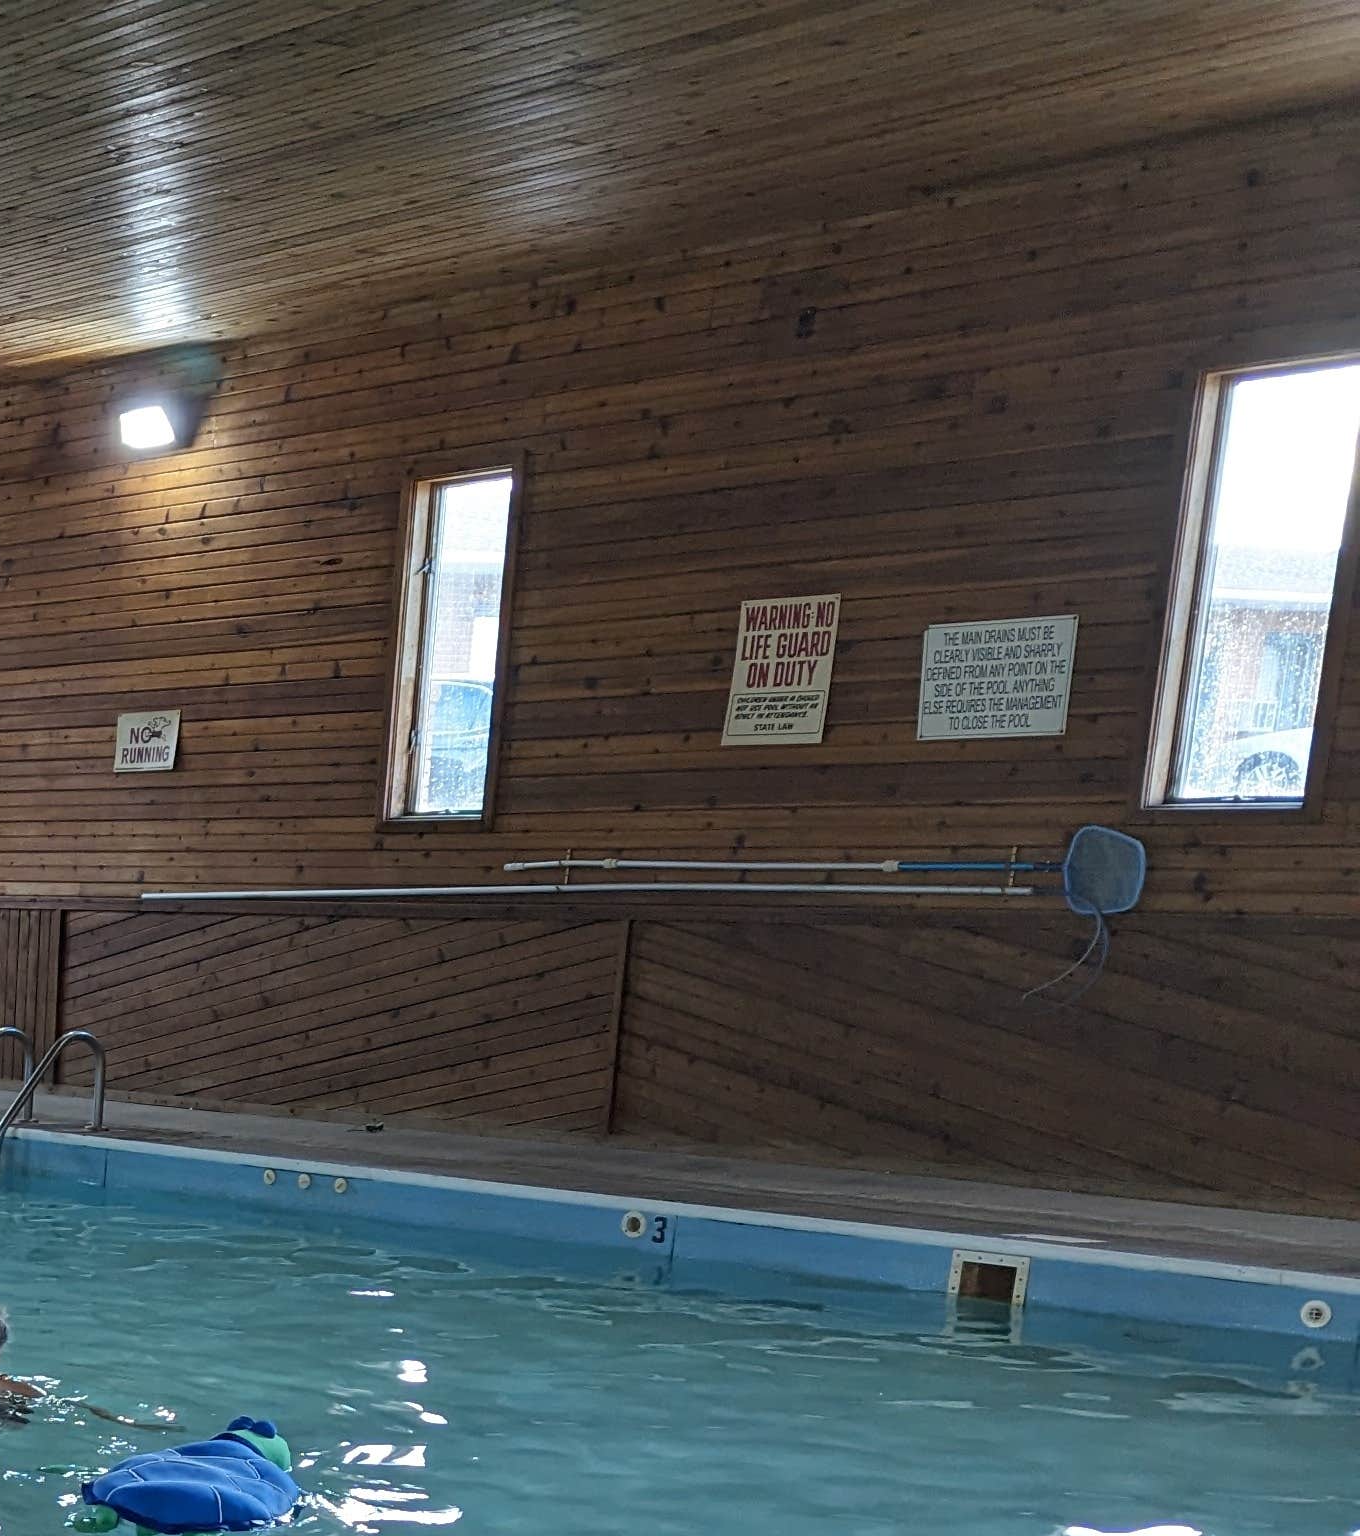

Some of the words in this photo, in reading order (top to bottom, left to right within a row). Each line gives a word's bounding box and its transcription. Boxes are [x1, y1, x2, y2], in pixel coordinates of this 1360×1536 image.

[815, 601, 835, 628] NO
[741, 634, 772, 661] LIFE
[776, 631, 831, 658] GUARD
[944, 632, 959, 646] THE
[962, 631, 982, 645] MAIN
[984, 629, 1015, 644] DRAINS
[1017, 627, 1041, 641] MUST
[1043, 626, 1055, 640] BE
[934, 649, 970, 664] CLEARLY
[971, 647, 1003, 661] VISIBLE
[1004, 645, 1022, 659] AND
[1024, 643, 1063, 658] SHARPLY
[746, 662, 770, 688] ON
[773, 660, 817, 687] DUTY
[926, 665, 961, 681] DEFINED
[964, 664, 988, 679] FROM
[989, 663, 1007, 677] ANY
[1008, 661, 1033, 676] POINT
[1035, 661, 1047, 675] ON
[1049, 660, 1066, 674] THE
[934, 683, 952, 697] SIDE
[955, 682, 967, 696] OF
[969, 681, 984, 695] THE
[1013, 677, 1055, 693] ANYTHING
[923, 700, 944, 715] ELSE
[945, 699, 986, 714] REQUIRES
[989, 698, 1004, 711] THE
[1005, 695, 1063, 710] MANAGEMENT
[949, 717, 959, 730] TO
[961, 715, 988, 730] CLOSE
[991, 715, 1006, 728] THE
[1007, 714, 1030, 728] POOL
[129, 727, 152, 744] NO
[121, 745, 170, 764] RUNNING
[651, 1216, 667, 1243] 3
